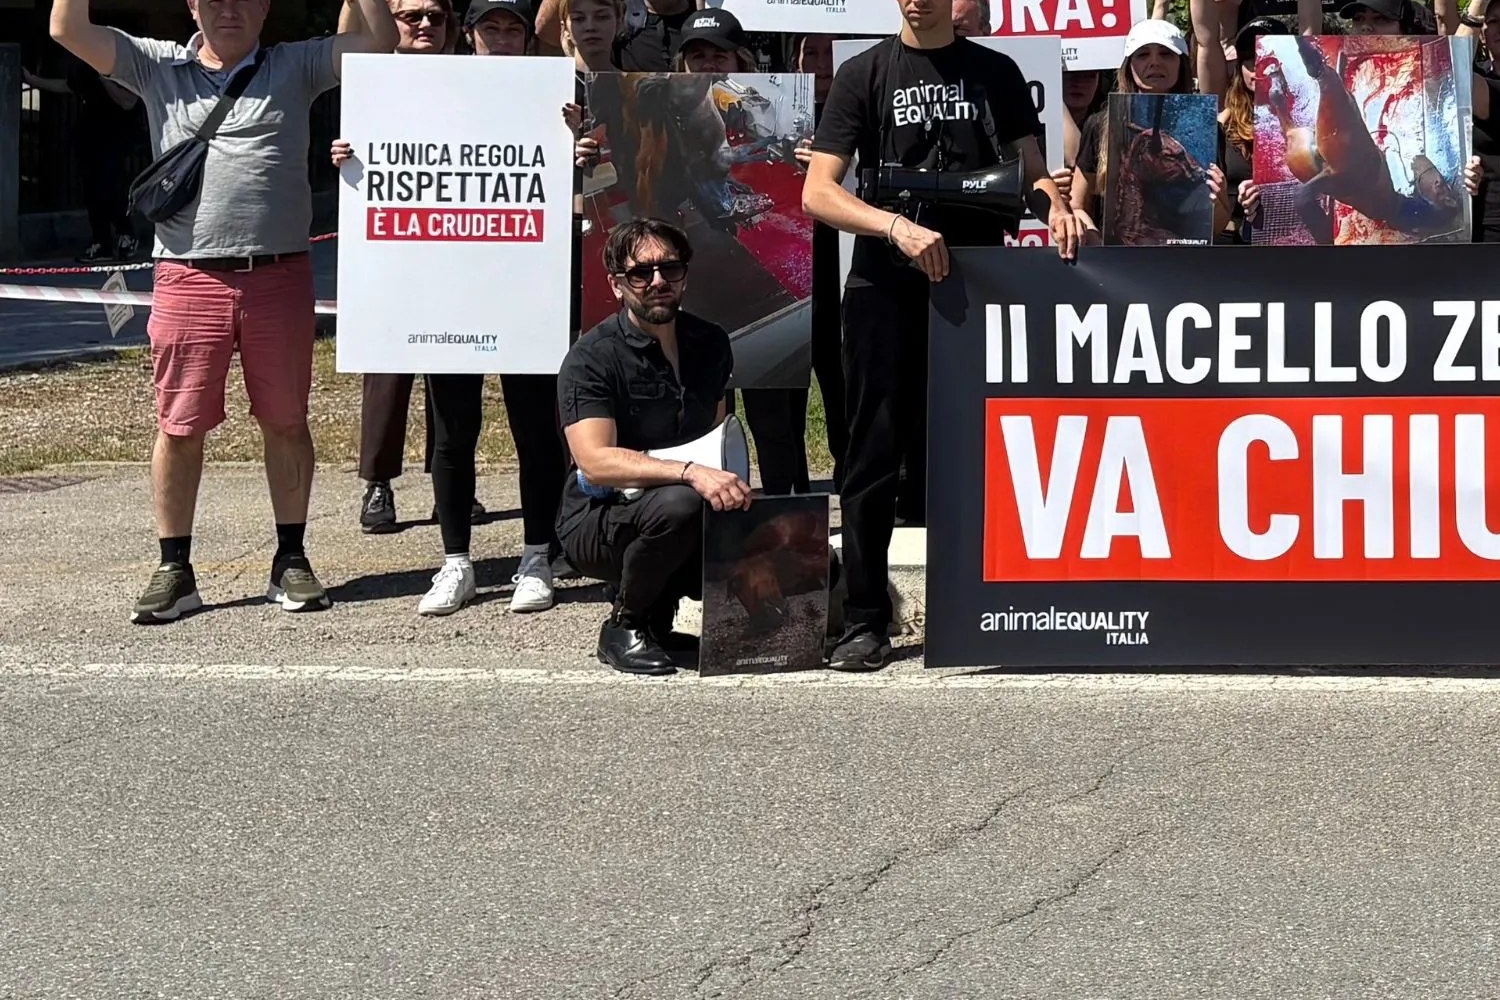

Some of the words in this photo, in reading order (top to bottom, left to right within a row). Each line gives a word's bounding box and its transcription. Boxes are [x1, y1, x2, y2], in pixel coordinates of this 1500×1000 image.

[892, 78, 964, 107] animal
[893, 101, 979, 127] EQUALITY
[461, 144, 545, 167] REGOLA
[368, 171, 545, 203] RISPETTATA
[962, 180, 987, 190] PYLE
[374, 207, 386, 235] È
[394, 213, 421, 235] LA
[426, 208, 538, 236] CRUDELTÀ
[408, 332, 497, 344] animalEQUALITY
[1056, 301, 1406, 384] MACELLO
[1000, 415, 1171, 559] VA
[981, 606, 1149, 631] animalEQUALITY
[1107, 633, 1148, 644] ITALIA
